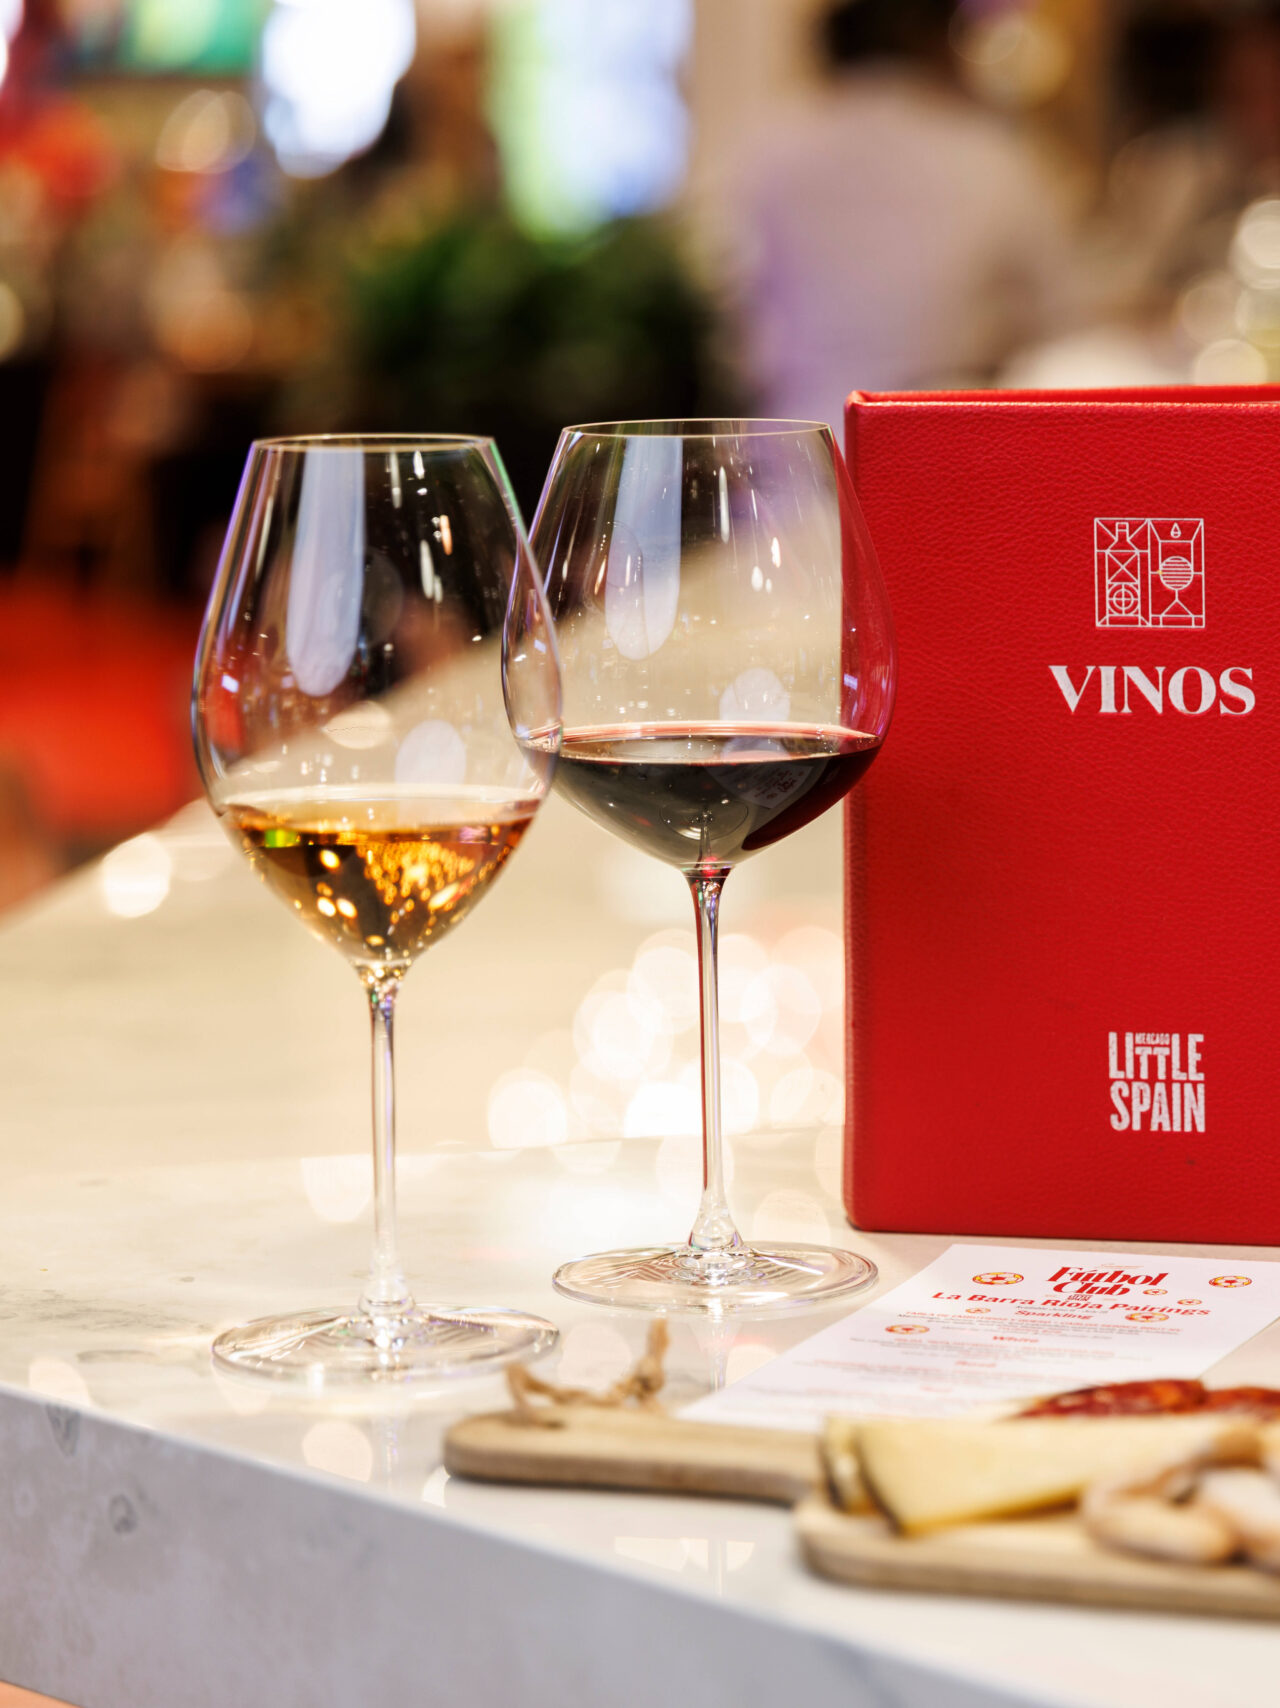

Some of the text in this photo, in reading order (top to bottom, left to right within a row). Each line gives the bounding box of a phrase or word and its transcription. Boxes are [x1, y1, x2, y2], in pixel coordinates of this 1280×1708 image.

[1048, 665, 1256, 715] VINOS
[1108, 1031, 1205, 1081] LITTLE
[1110, 1080, 1205, 1133] SPAIN
[1046, 1266, 1169, 1286] Fútbol
[1053, 1281, 1130, 1296] Club
[932, 1292, 961, 1300] La
[967, 1294, 1035, 1305] Barra
[1041, 1299, 1103, 1310] Rioja
[1109, 1303, 1212, 1316] Pairings
[1015, 1309, 1094, 1320] Sparkling
